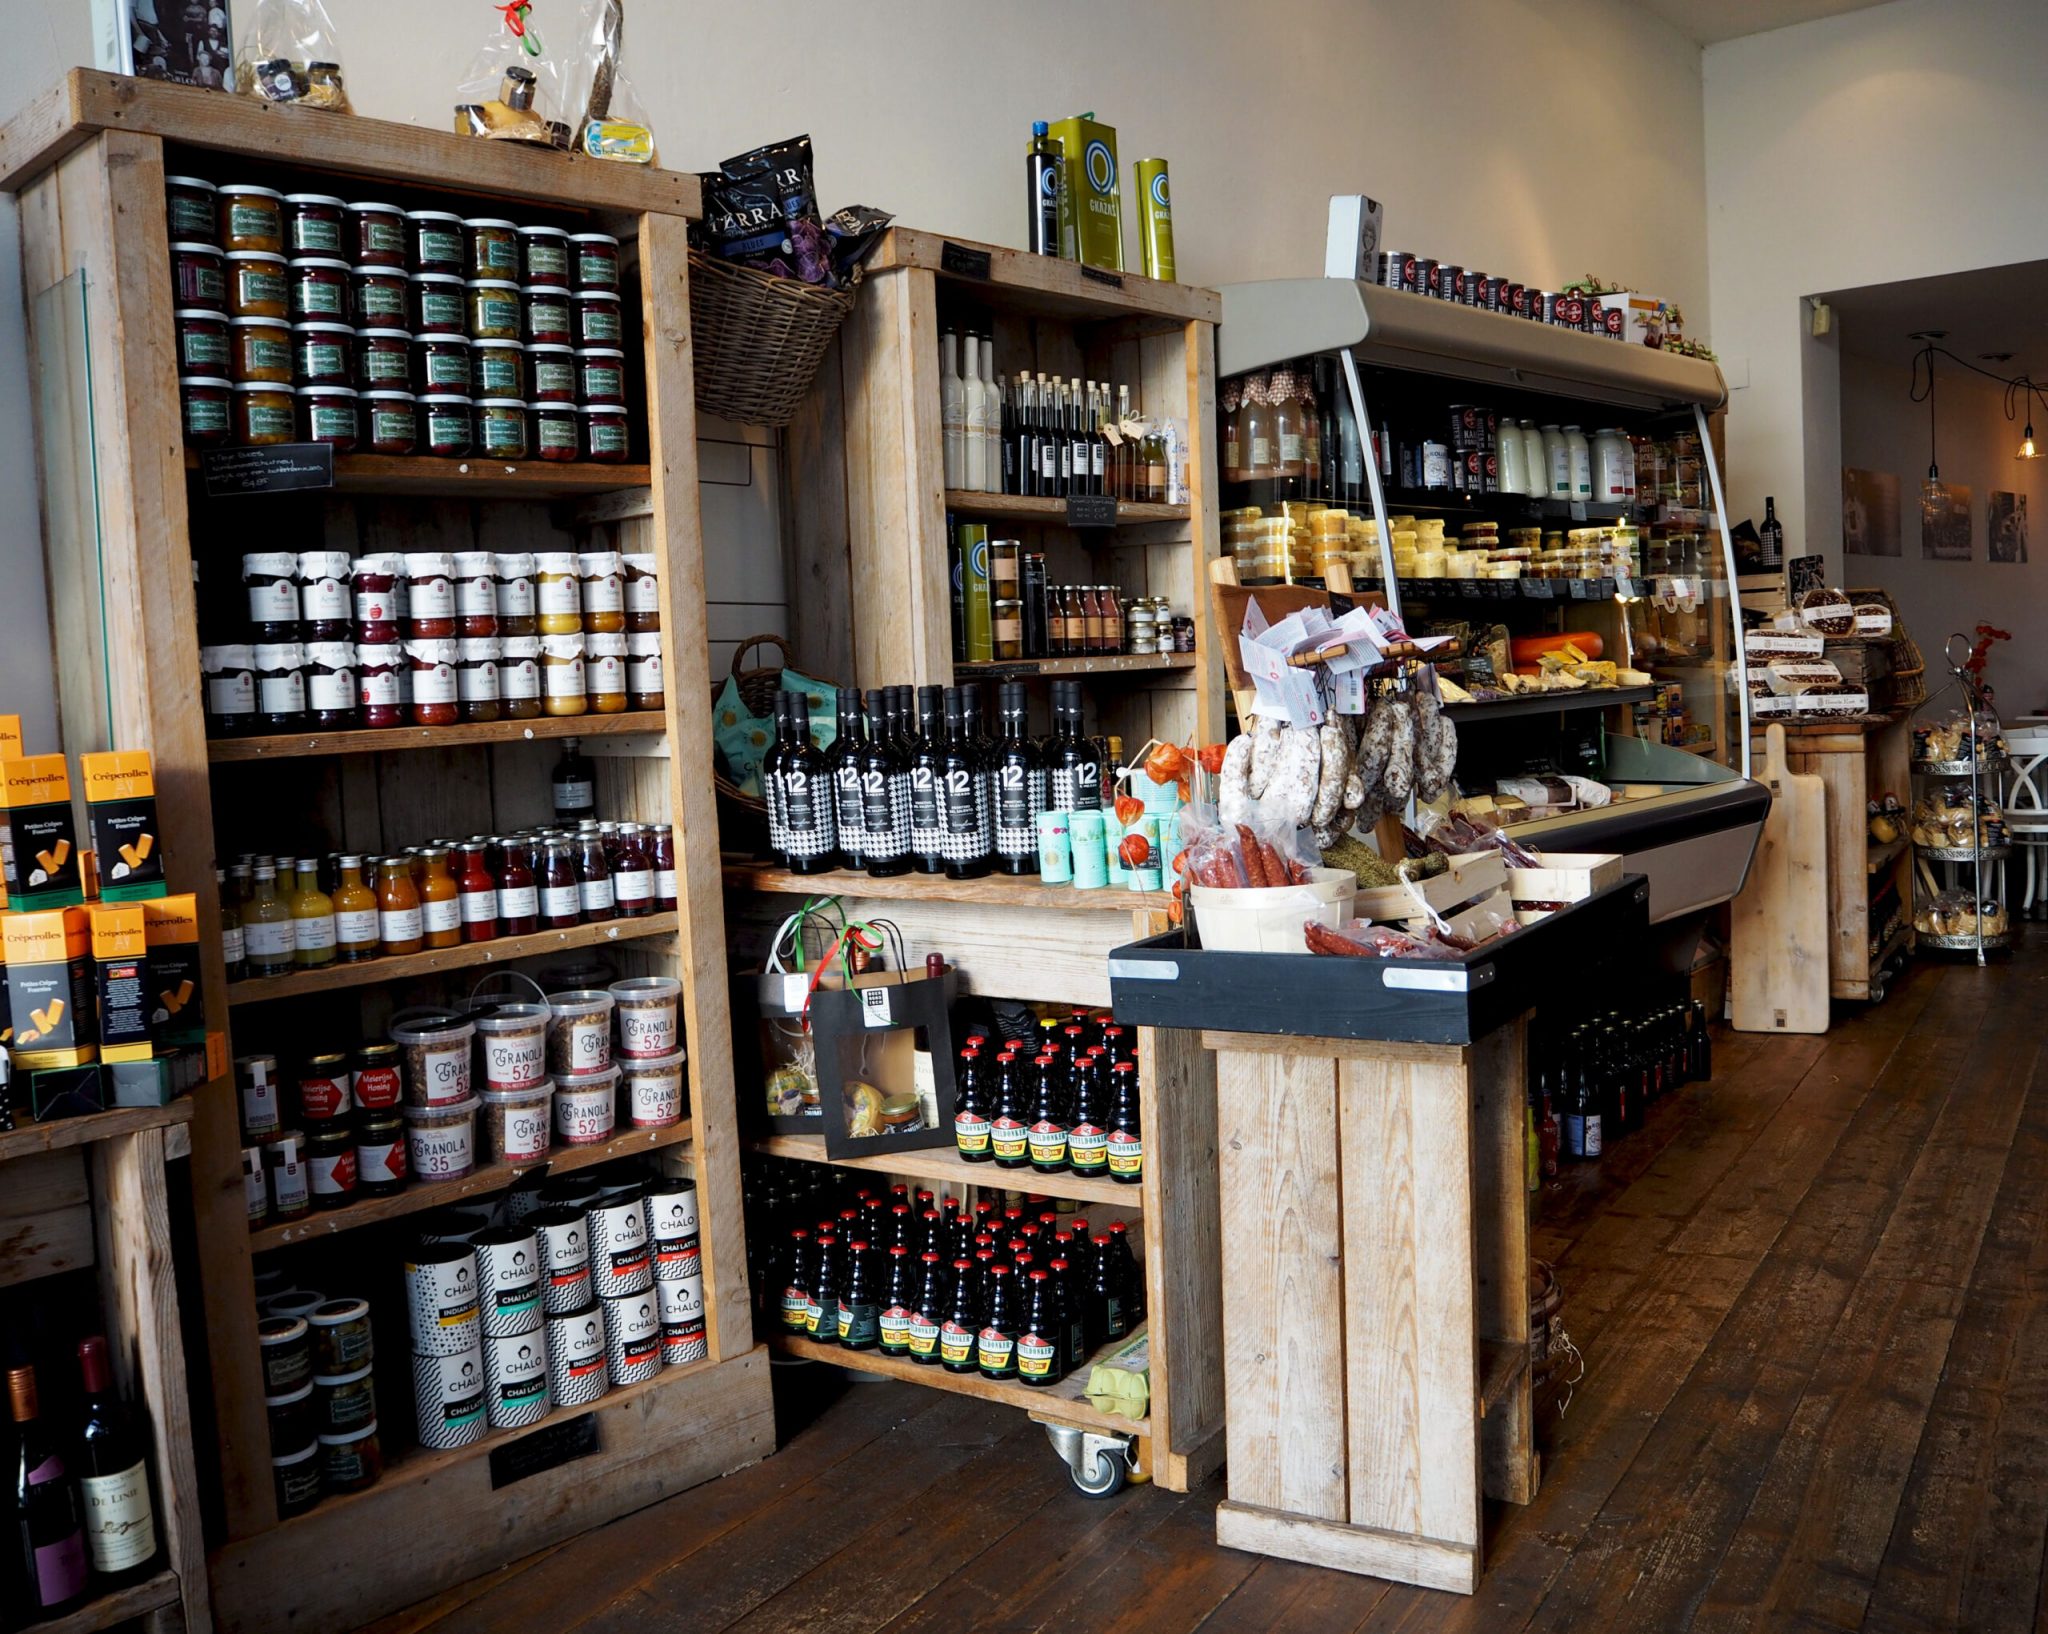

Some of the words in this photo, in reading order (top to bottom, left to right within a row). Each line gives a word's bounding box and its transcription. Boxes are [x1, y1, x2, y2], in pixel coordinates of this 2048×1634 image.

[776, 165, 809, 188] RRA
[707, 203, 783, 232] TERRA
[1392, 263, 1400, 289] BUITE
[9, 774, 65, 786] Crêperolles
[93, 769, 149, 781] Crêperolles
[785, 771, 807, 793] 12
[838, 767, 858, 788] 12
[910, 767, 932, 788] 12
[945, 770, 970, 793] 12
[1000, 765, 1023, 788] 12
[1075, 762, 1097, 785] 12
[862, 772, 885, 793] 12
[24, 822, 45, 830] Petites
[108, 816, 129, 825] Petites
[7, 932, 62, 943] Crêperolles
[98, 928, 142, 938] Crêperolles
[626, 1018, 673, 1037] GRANOLA
[581, 1034, 608, 1052] GRAN
[644, 1035, 661, 1050] 52
[493, 1048, 543, 1067] GRANOLA
[362, 1073, 393, 1083] Meierijse
[435, 1062, 467, 1082] GRAN
[513, 1064, 530, 1081] 52
[367, 1084, 390, 1092] Honing
[456, 1076, 469, 1093] 52
[638, 1088, 681, 1105] GRANOLA
[560, 1102, 609, 1121] GRANOLA
[657, 1102, 672, 1118] 52
[514, 1120, 546, 1138] GRAN
[579, 1119, 596, 1134] 52
[412, 1138, 465, 1158] GRANOLA
[533, 1133, 546, 1150] 52
[429, 1156, 449, 1172] 35
[660, 1216, 695, 1231] CHALO
[661, 1243, 680, 1252] CHAI
[617, 1256, 634, 1265] CHAI
[500, 1263, 535, 1280] CHALO
[555, 1268, 577, 1276] INDIAN
[444, 1279, 475, 1298] CHALO
[502, 1294, 521, 1304] CHAI
[666, 1300, 700, 1315] CHALO
[443, 1305, 468, 1317] INDIAN
[667, 1327, 685, 1336] CHAI
[630, 1345, 648, 1354] CHAI
[505, 1356, 542, 1374] CHALO
[573, 1357, 596, 1367] INDIAN
[449, 1372, 481, 1392] CHALO
[507, 1387, 527, 1397] CHAI
[450, 1406, 469, 1417] CHAI
